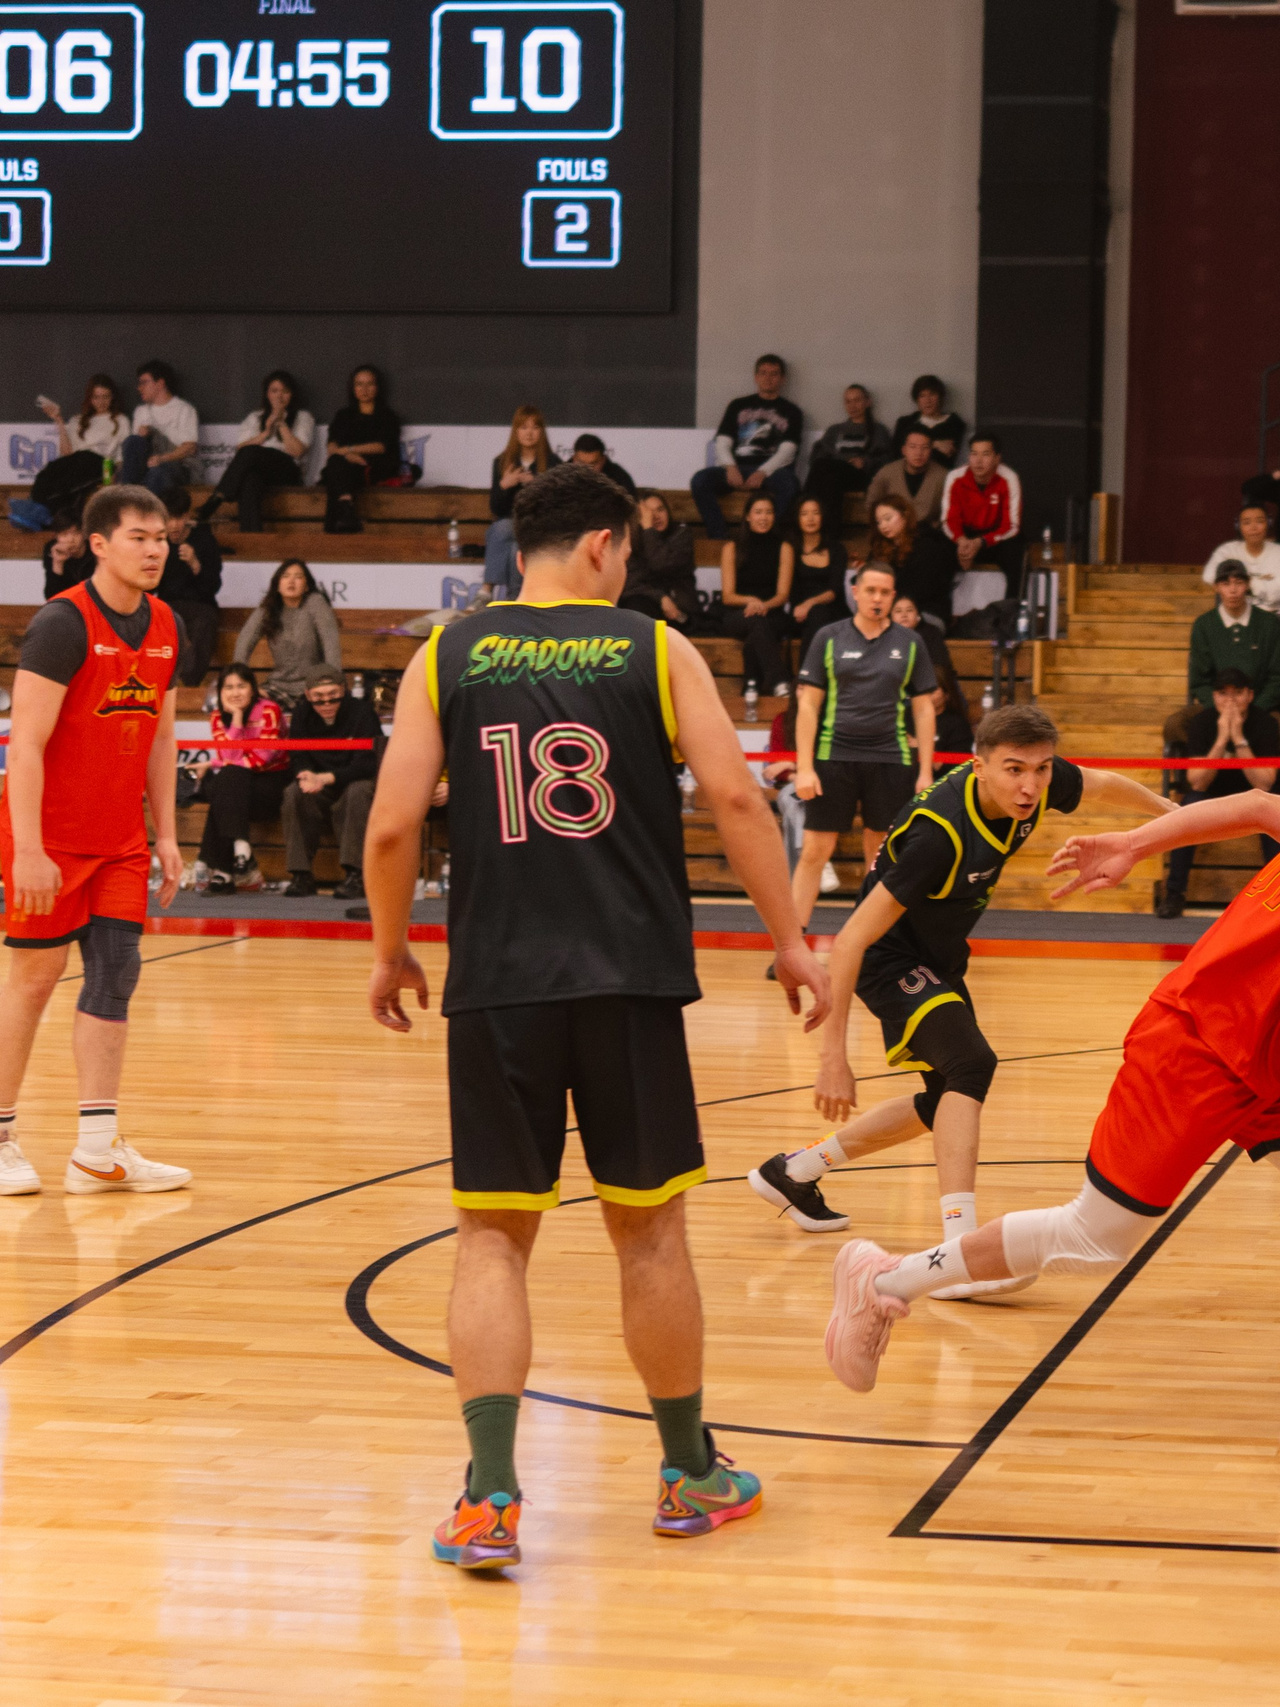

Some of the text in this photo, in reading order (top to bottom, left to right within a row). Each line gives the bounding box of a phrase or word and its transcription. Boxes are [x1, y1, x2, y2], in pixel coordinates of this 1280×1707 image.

[0, 29, 112, 113] 06
[184, 40, 390, 107] 04:55
[470, 27, 582, 112] 10
[537, 158, 608, 181] FOULS
[554, 203, 590, 252] 2
[464, 634, 633, 680] SHADOWS
[480, 723, 616, 843] 18
